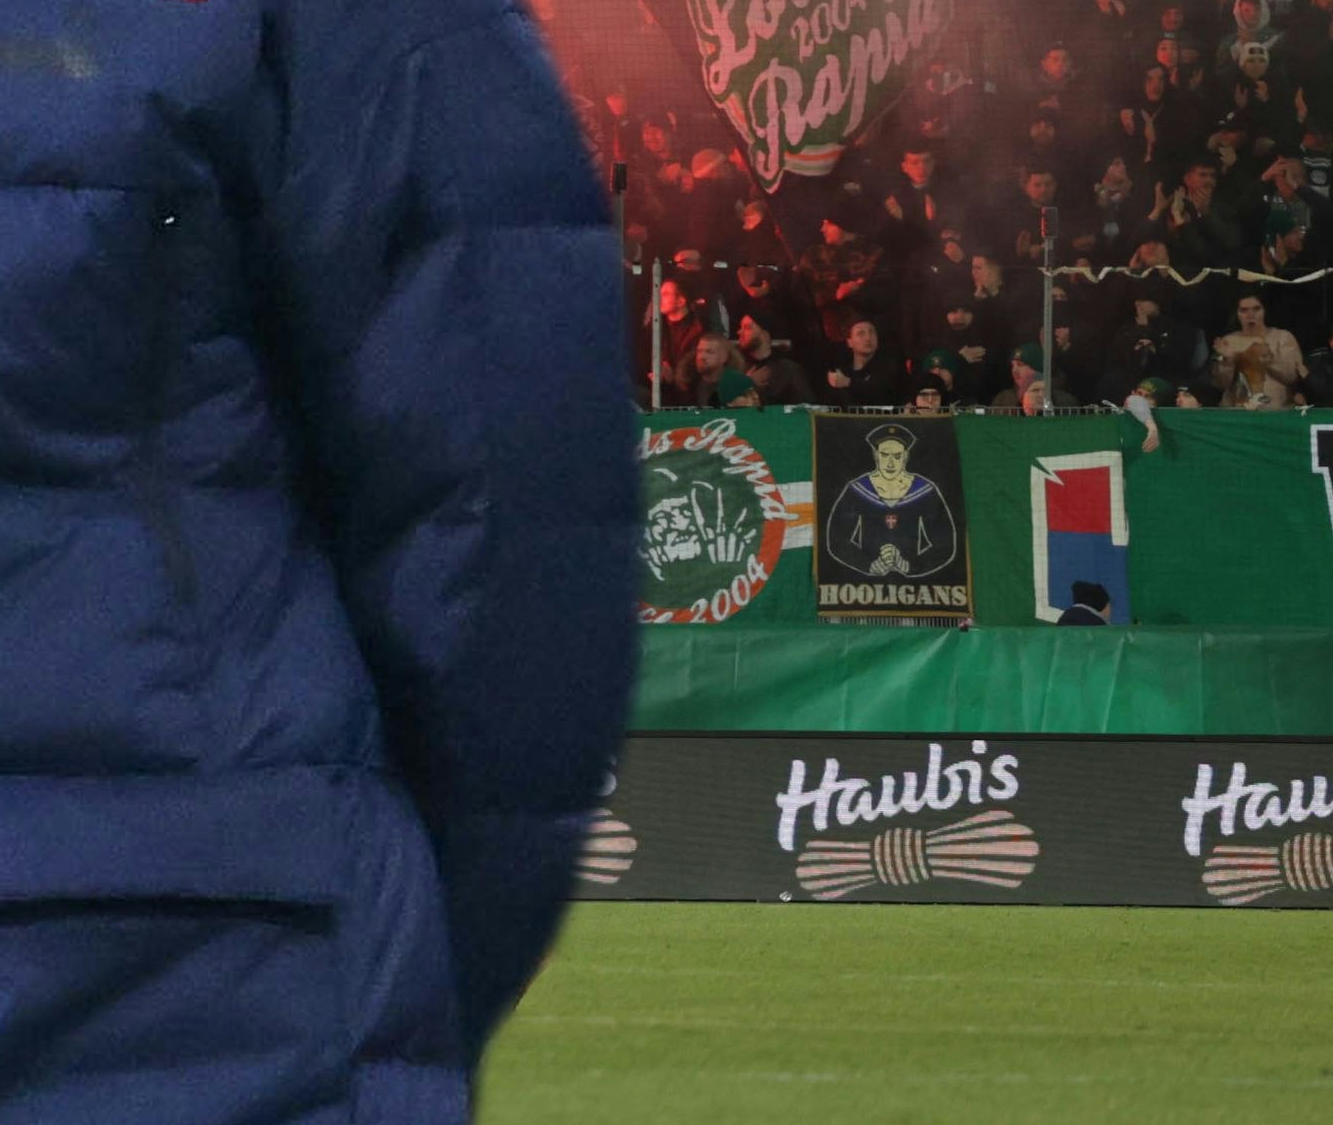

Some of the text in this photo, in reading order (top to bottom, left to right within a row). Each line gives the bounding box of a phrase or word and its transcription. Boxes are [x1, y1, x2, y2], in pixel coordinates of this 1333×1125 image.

[684, 418, 799, 520] Rapid
[690, 554, 768, 623] 2004
[819, 582, 968, 606] HOOLIGANS
[776, 739, 1019, 852] Haubis
